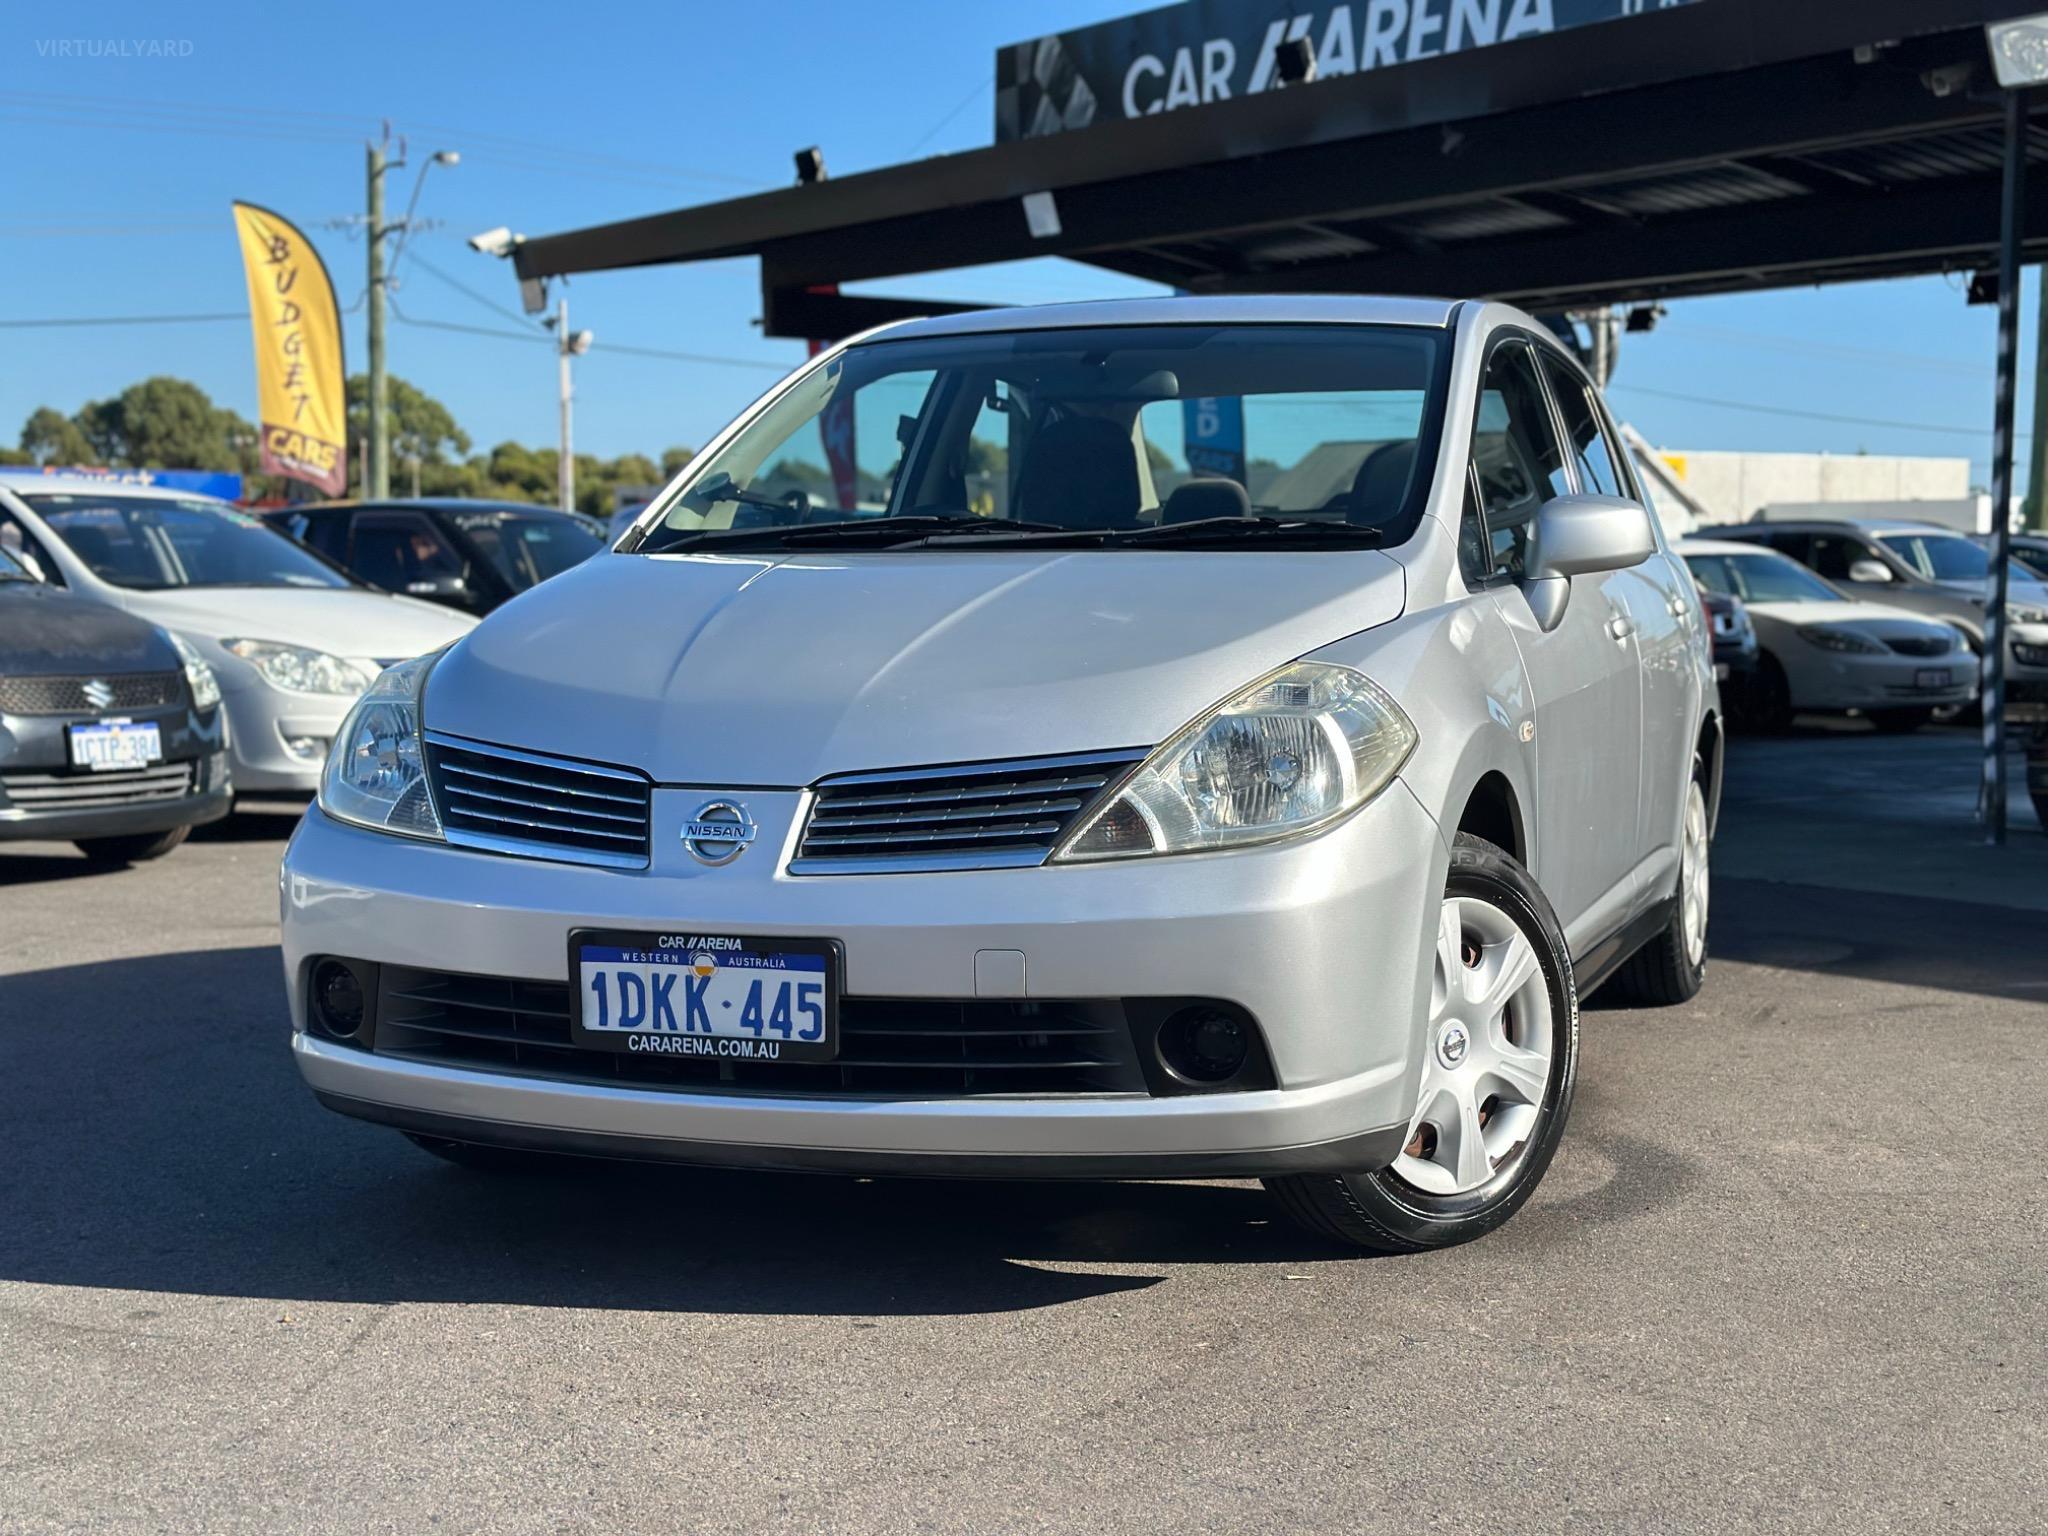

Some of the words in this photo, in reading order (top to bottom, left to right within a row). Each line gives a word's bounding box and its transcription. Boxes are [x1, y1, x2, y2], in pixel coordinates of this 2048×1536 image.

[1122, 38, 1236, 119] CAR
[265, 234, 312, 422] BUDGET
[267, 428, 338, 470] CARS
[687, 825, 746, 838] NISSAN
[658, 936, 685, 949] CAR
[622, 953, 679, 964] WESTERN
[728, 957, 786, 968] AUSTRALIA
[628, 1034, 780, 1059] CARARENA.COM.AU
